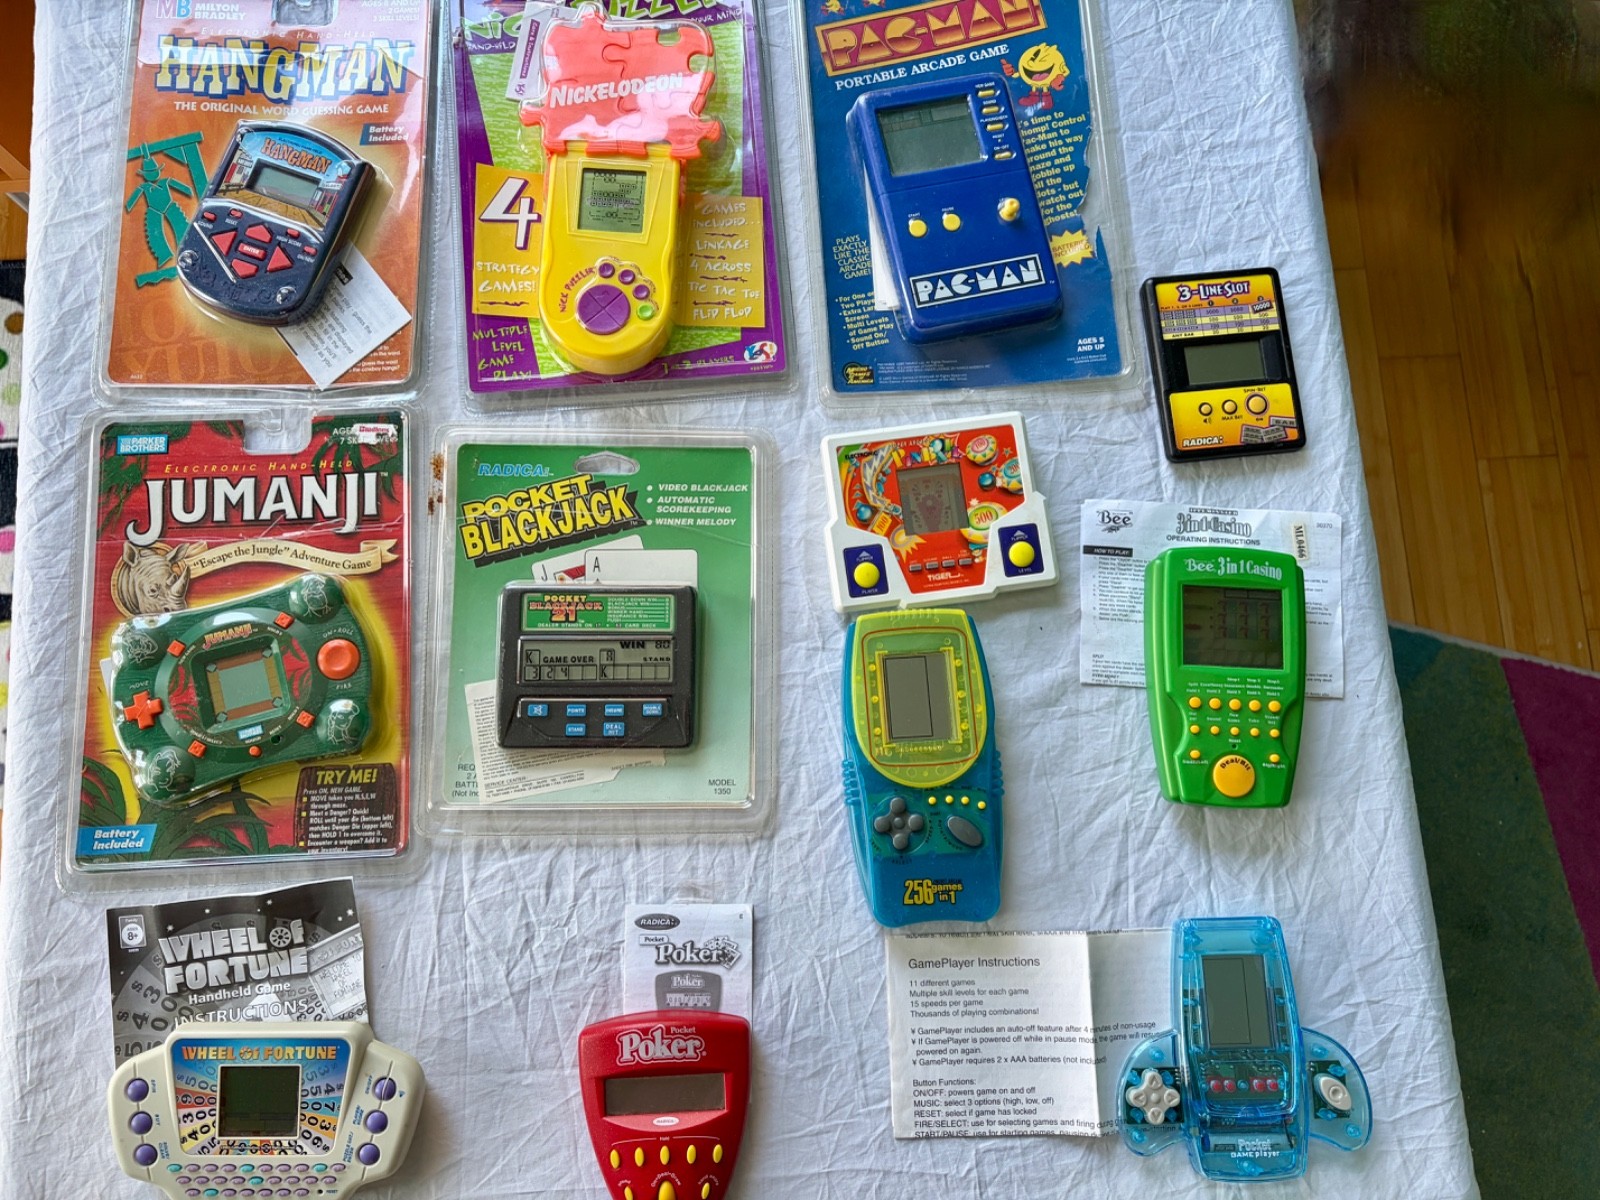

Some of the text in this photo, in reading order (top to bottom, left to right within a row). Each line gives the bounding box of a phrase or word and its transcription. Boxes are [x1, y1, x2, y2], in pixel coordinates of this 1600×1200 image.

[195, 3, 239, 12] MILTON
[194, 12, 246, 21] BRADLEY
[825, 0, 1035, 68] PAC-MAN
[156, 34, 415, 104] HANGMAN
[835, 44, 1010, 91] PORTABLE ARCADE GAME
[550, 73, 683, 108] NICKELODEON
[174, 101, 389, 115] THE ORIGINAL WORD GUESSING GAME
[1021, 114, 1086, 136] homp! Control
[1031, 111, 1064, 126] time to
[368, 124, 404, 135] Battery
[368, 132, 409, 142] Included
[1049, 134, 1083, 148] his way
[262, 138, 331, 174] HANGMAN
[479, 176, 541, 250] 4
[702, 202, 747, 214] GAMES
[1044, 209, 1078, 226] ghosts!
[696, 239, 750, 250] LINKAGE
[836, 234, 860, 245] PLAYS
[833, 240, 867, 253] EXACTLY
[834, 247, 870, 260] LIKE THE
[837, 254, 870, 266] CLASSIC
[476, 261, 540, 275] STRATEGY
[691, 261, 752, 272] 4 ACROSS
[840, 261, 872, 273] ARCADE
[478, 280, 536, 293] GAMES!
[915, 259, 1041, 302] PAC-MAN
[689, 282, 760, 298] TIC TAC TOE
[1223, 282, 1249, 298] SLOT
[693, 306, 752, 320] FLIP FLOP
[866, 317, 889, 325] Levels
[473, 324, 529, 340] MULTIPLE
[858, 327, 878, 335] Game
[492, 341, 525, 353] LEVEL
[1077, 337, 1097, 345] AGES
[478, 354, 514, 370] GAME
[493, 369, 532, 381] PLAY!
[131, 436, 166, 445] PARKER
[120, 444, 166, 453] BROTHERS
[845, 451, 878, 460] ELECTRONIC
[164, 459, 352, 474] ELECTRONIC HAND-HELD
[658, 484, 748, 492] VIDEO BLACKJACK
[462, 473, 592, 524] POCKET
[658, 496, 715, 505] AUTOMATIC
[126, 471, 379, 547] JUMANJI
[656, 505, 731, 514] SCOREKEEPING
[459, 485, 635, 559] BLACKJACK
[655, 518, 736, 526] WINNER MELODY
[974, 510, 994, 523] 500
[1176, 513, 1186, 535] 3
[1209, 517, 1252, 538] Casino
[1167, 535, 1260, 546] OPERATING INSTRUCTIONS
[234, 546, 250, 558] the
[290, 548, 341, 568] Adventure
[342, 559, 372, 570] Game
[593, 557, 600, 572] A
[540, 564, 548, 581] J
[1217, 557, 1225, 576] 3
[1226, 558, 1237, 575] in
[1239, 559, 1246, 575] 1
[1246, 559, 1283, 580] Casino
[928, 572, 951, 580] TIGER
[530, 602, 603, 610] BLACKJACK
[552, 609, 576, 622] 21
[203, 623, 252, 650] JUMANJI
[620, 641, 670, 649] WIN 80
[543, 656, 568, 664] GAME
[317, 768, 378, 785] TRY ME!
[94, 829, 139, 840] Battery
[93, 838, 144, 850] Included
[904, 879, 962, 904] 256 games
[940, 892, 948, 901] in
[127, 931, 139, 942] 8+
[158, 926, 268, 965] WHEEL
[656, 941, 723, 965] Poker
[908, 957, 1041, 970] GamePlayer Instructions
[164, 947, 309, 995] FORTUNE
[920, 979, 949, 987] different
[951, 980, 975, 988] games
[188, 981, 291, 1006] Handheld Game
[910, 989, 937, 998] Multiple
[939, 989, 953, 997] skill
[955, 988, 975, 996] levels
[1008, 988, 1029, 997] game
[921, 1000, 947, 1009] speeds
[949, 1001, 961, 1009] per
[963, 999, 983, 1008] game
[173, 999, 308, 1029] INSTRUCTIONS
[911, 1010, 950, 1018] Thousands
[961, 1009, 987, 1018] playing
[988, 1007, 1040, 1016] combinations!
[671, 1026, 696, 1034] Pocket
[617, 1024, 702, 1065] Poker
[181, 1046, 235, 1061] WHEEL
[263, 1046, 337, 1060] FORTUNE
[913, 1078, 976, 1087] Button Functions:
[913, 1089, 946, 1097] ON/OFF:
[948, 1089, 974, 1097] powers
[976, 1088, 997, 1096] game
[914, 1100, 942, 1108] MUSIC:
[974, 1098, 1000, 1106] options
[1003, 1097, 1023, 1106] (high,
[1041, 1097, 1054, 1105] off)
[1237, 1139, 1272, 1151] Pocket
